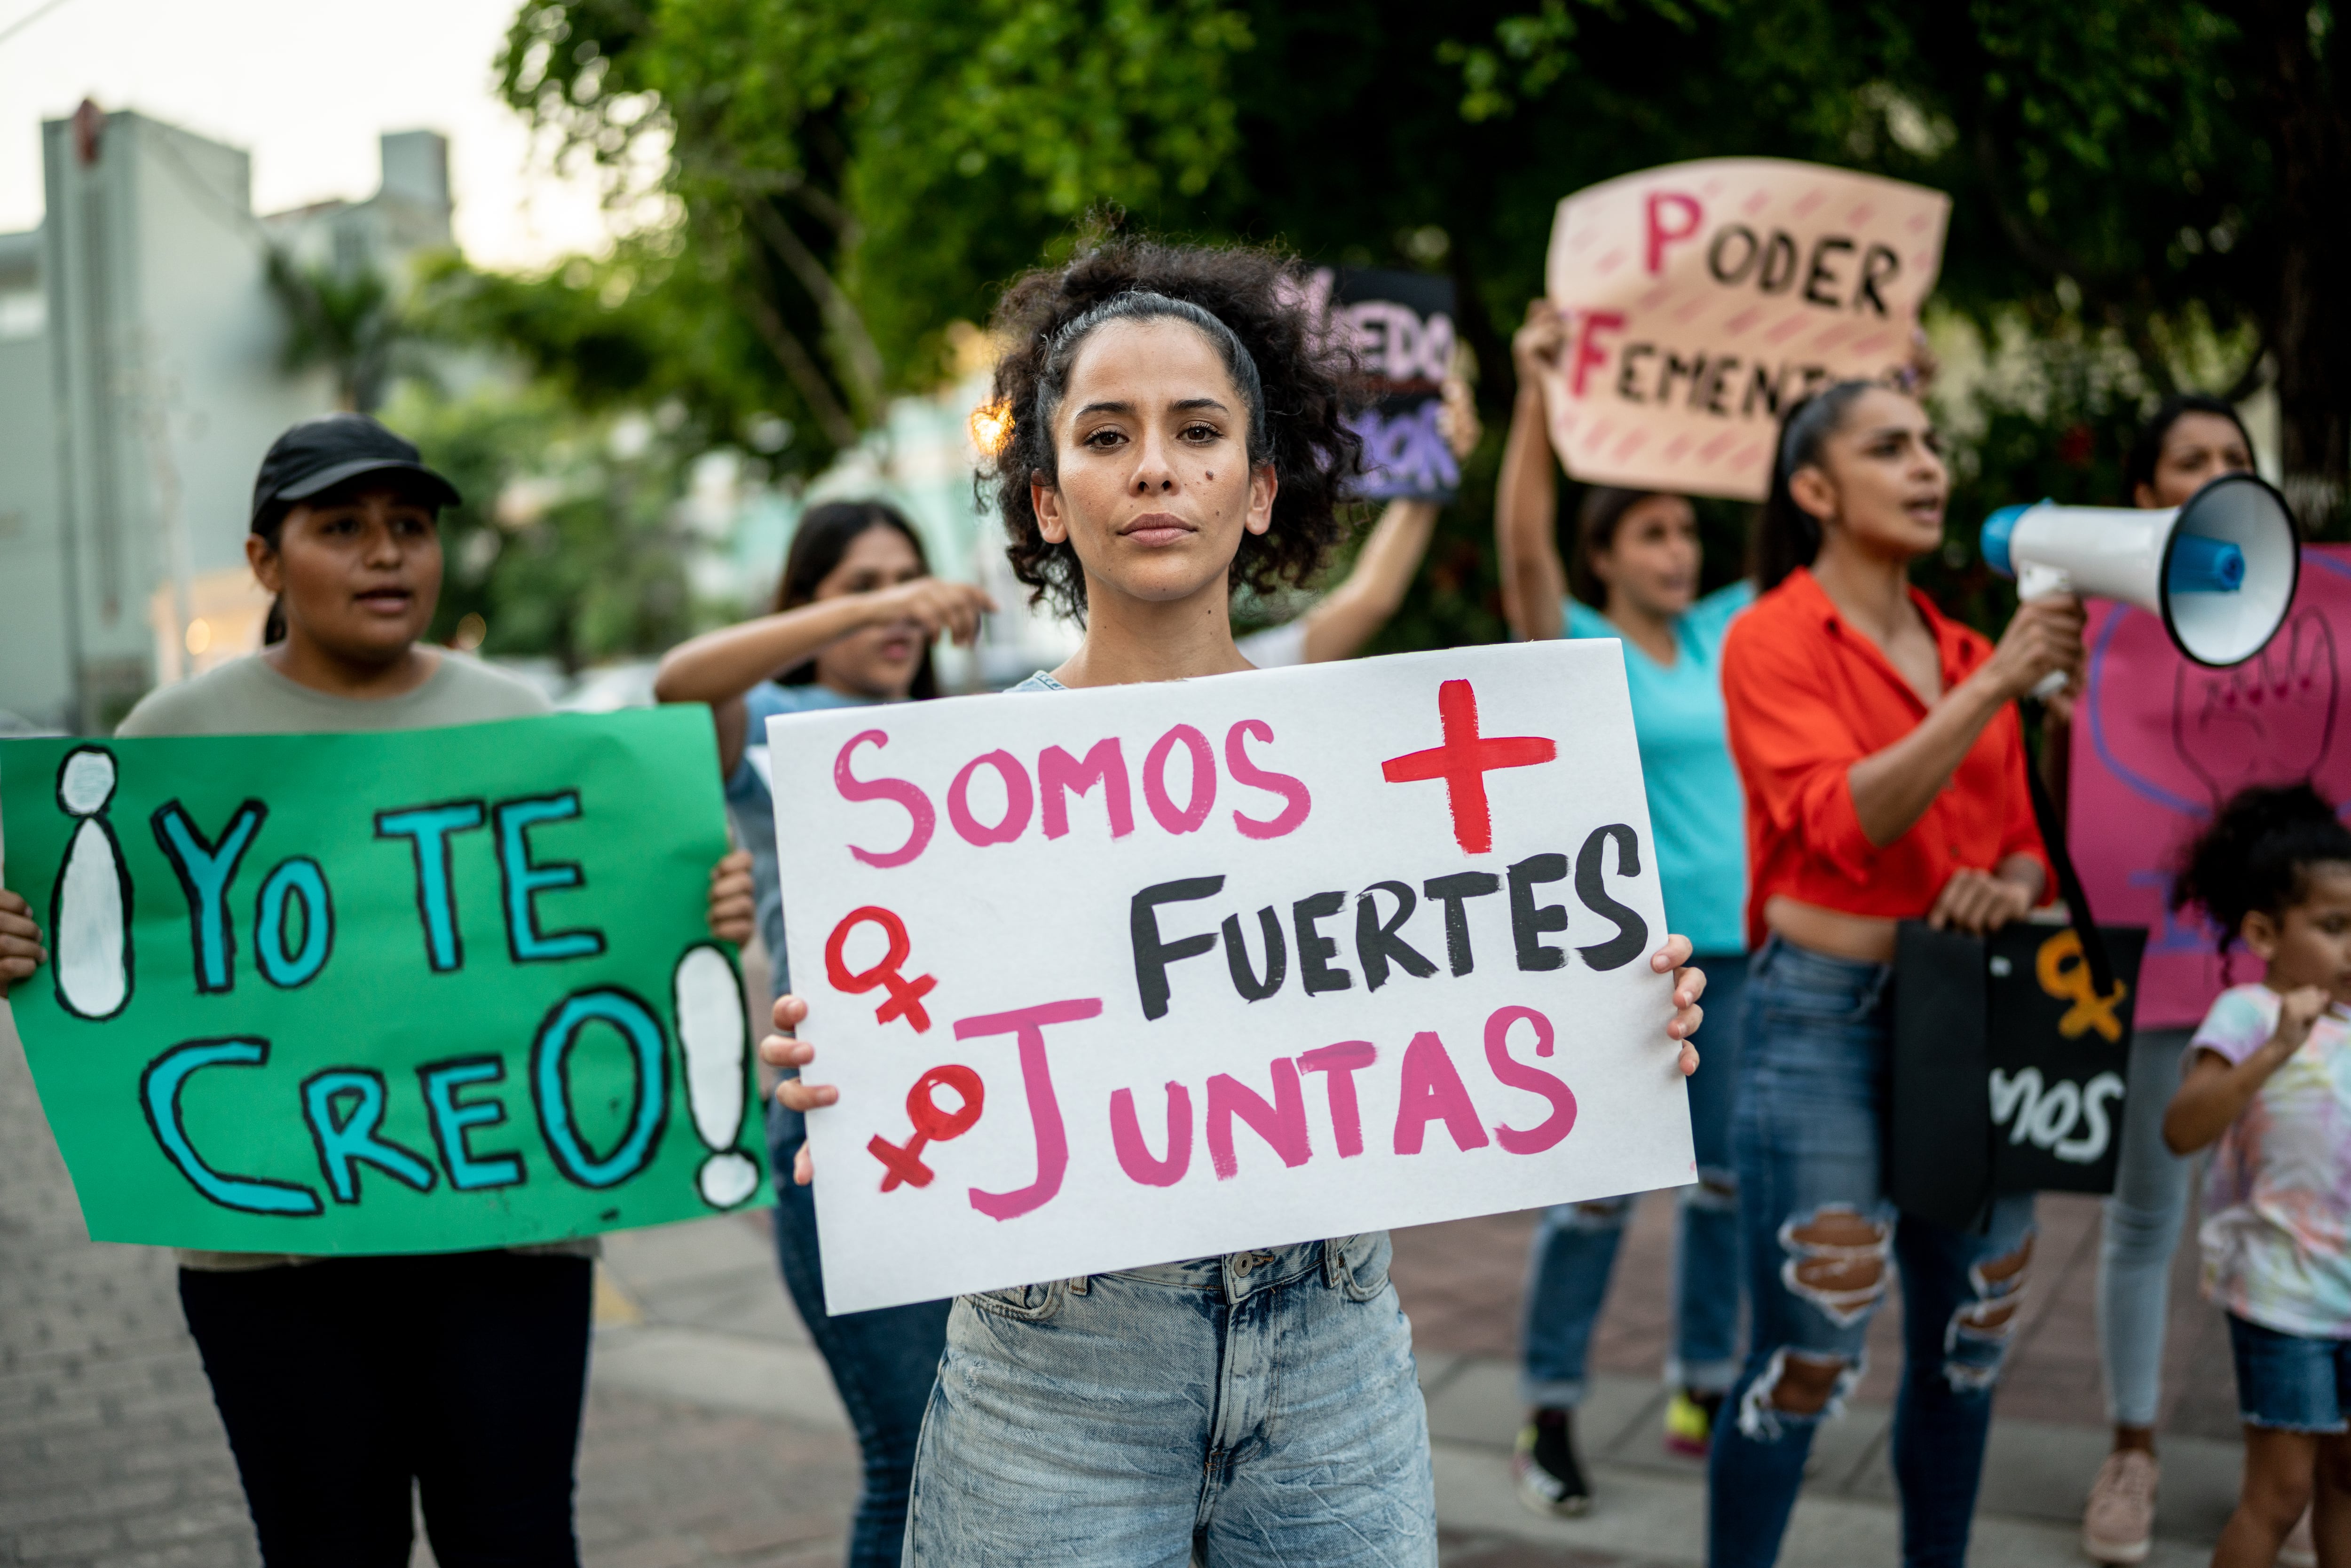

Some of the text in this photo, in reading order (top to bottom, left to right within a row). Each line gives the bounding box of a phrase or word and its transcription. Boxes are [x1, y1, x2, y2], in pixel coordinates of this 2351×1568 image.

[1643, 189, 1902, 317] PODER
[374, 789, 608, 974] TE
[834, 719, 1311, 868] SOMOS
[1130, 823, 1648, 1021] FUERTES
[139, 936, 764, 1218] CREO!
[953, 998, 1578, 1222] JUNTAS
